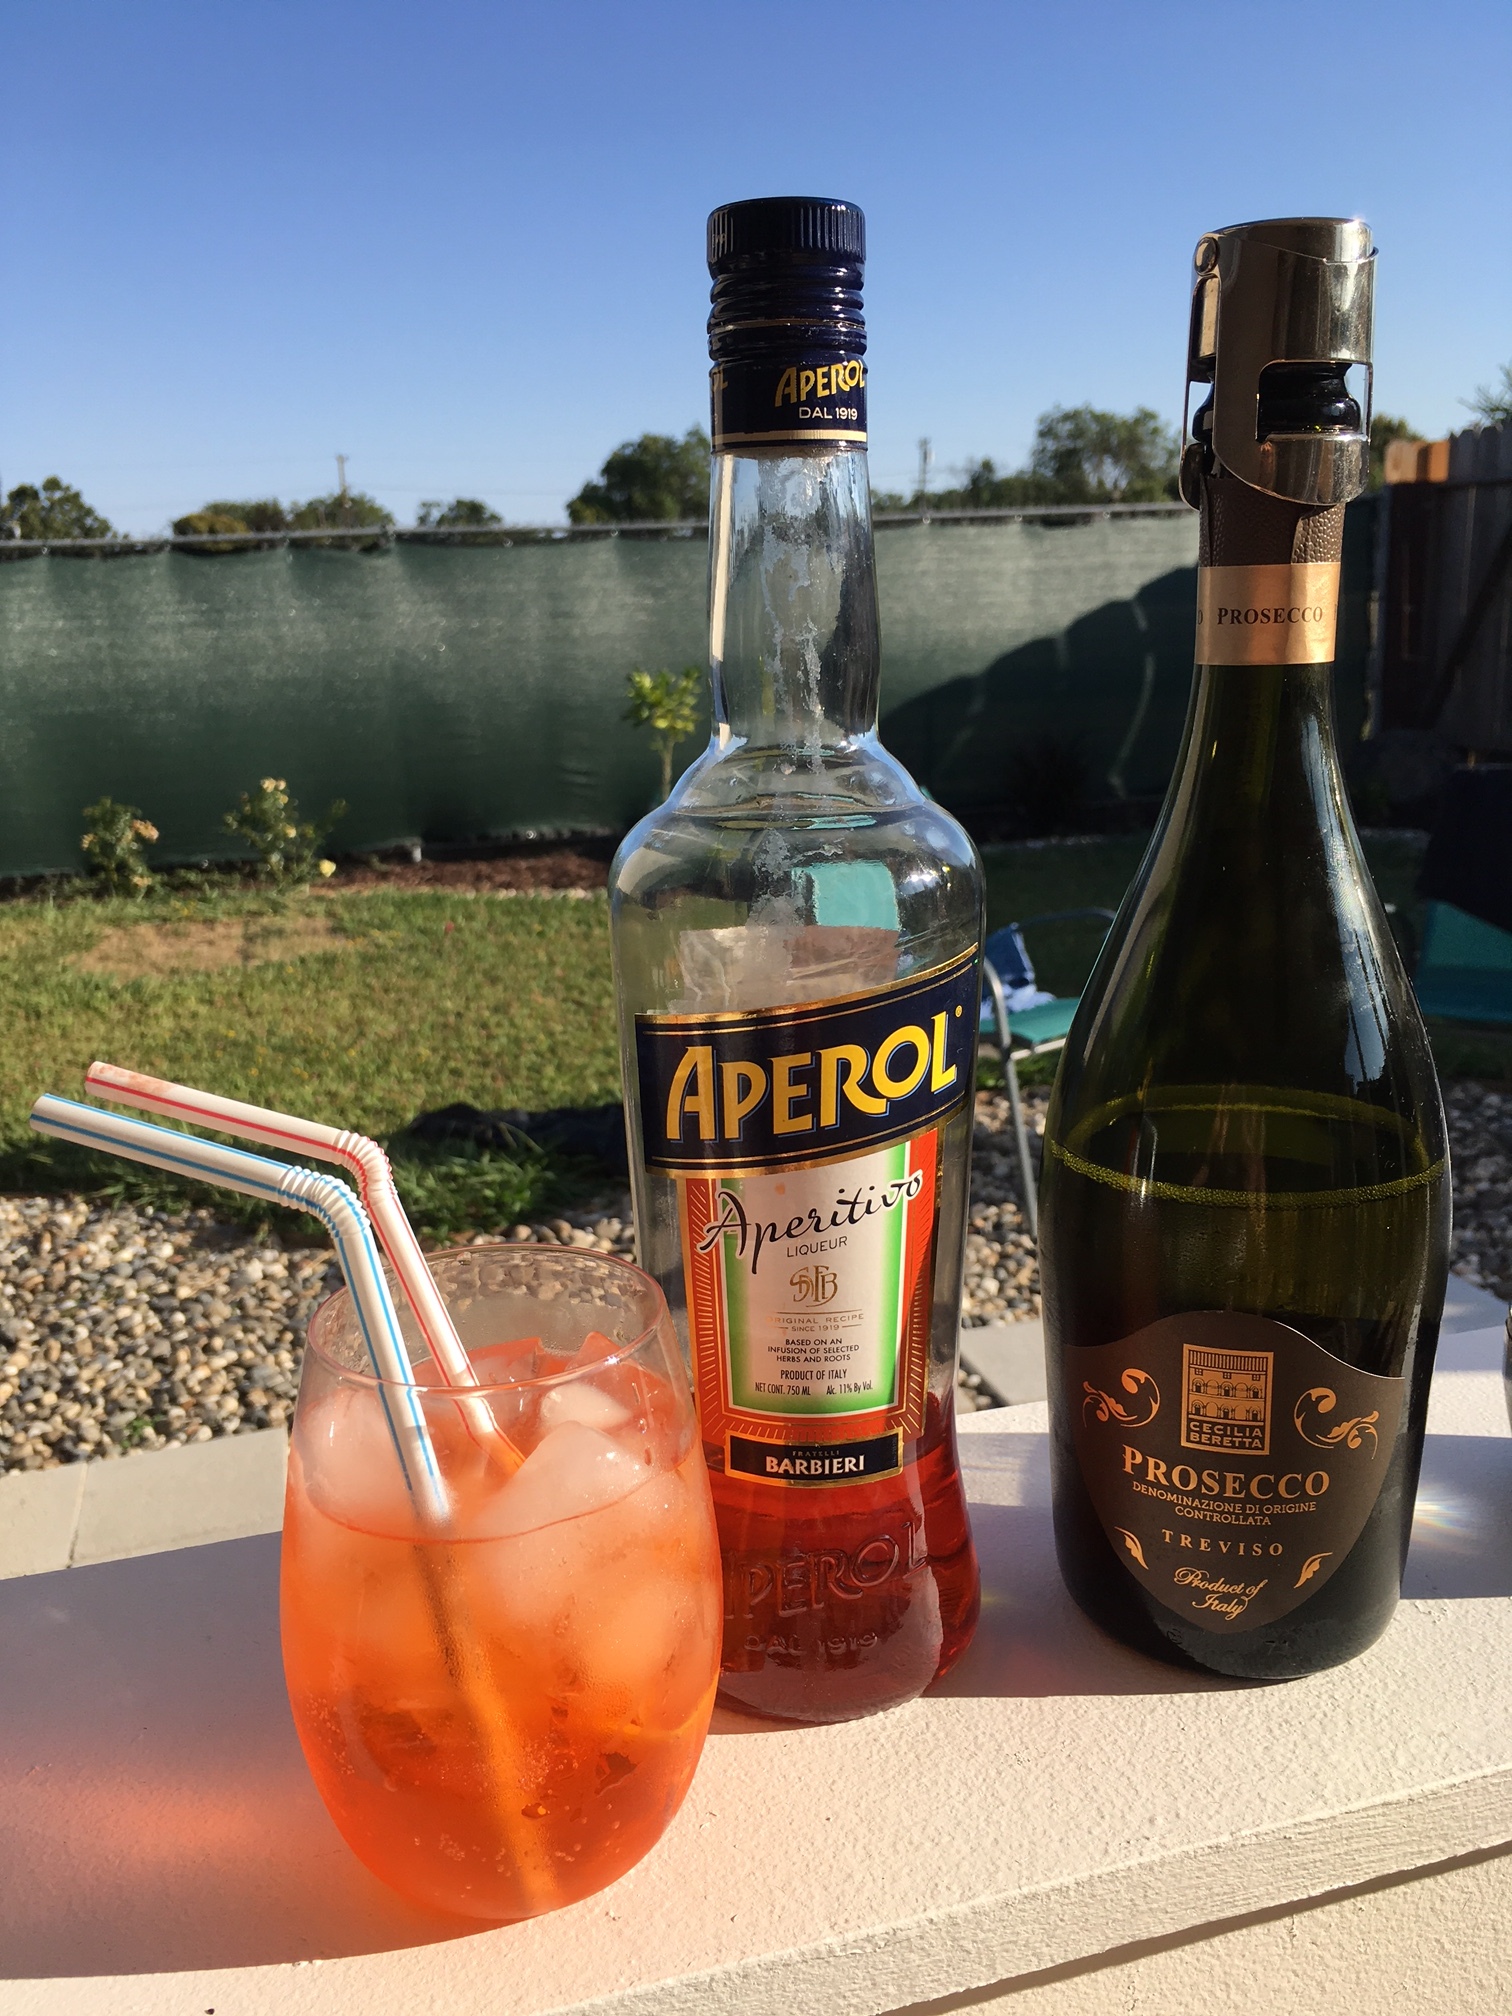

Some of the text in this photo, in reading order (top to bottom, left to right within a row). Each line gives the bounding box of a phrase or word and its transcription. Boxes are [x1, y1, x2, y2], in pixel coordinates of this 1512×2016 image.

[774, 359, 865, 408] APEROL
[798, 406, 858, 421] DAL 1919
[1217, 606, 1323, 625] PROSECCO
[666, 1011, 958, 1143] APEROL
[699, 1174, 923, 1275] Aperitivo
[786, 1236, 848, 1258] LIQUEUR
[766, 1313, 865, 1325] ORIGINAL RECIPE
[767, 1346, 807, 1355] INFUSION
[823, 1344, 860, 1353] SELECTED
[785, 1337, 843, 1346] BASED ON AN
[776, 1354, 851, 1363] HERBS AND ROOTS
[780, 1368, 848, 1380] PRODUCT OF ITALY
[754, 1382, 811, 1396] NET CONT. 750 ML
[839, 1382, 853, 1394] 11%
[854, 1382, 862, 1394] By
[862, 1380, 874, 1392] Vol.
[1189, 1421, 1263, 1438] CECILIA
[1189, 1431, 1263, 1449] BERETTA
[765, 1454, 865, 1475] BARBIERI
[1122, 1444, 1331, 1500] PROSECCO
[1132, 1480, 1318, 1515] DENOMINAZIONE DI ORIGINE
[1174, 1506, 1272, 1526] CONTROLLATA
[1161, 1528, 1284, 1557] TREVISO
[1173, 1567, 1268, 1602] Product of
[1191, 1593, 1248, 1621] Italy
